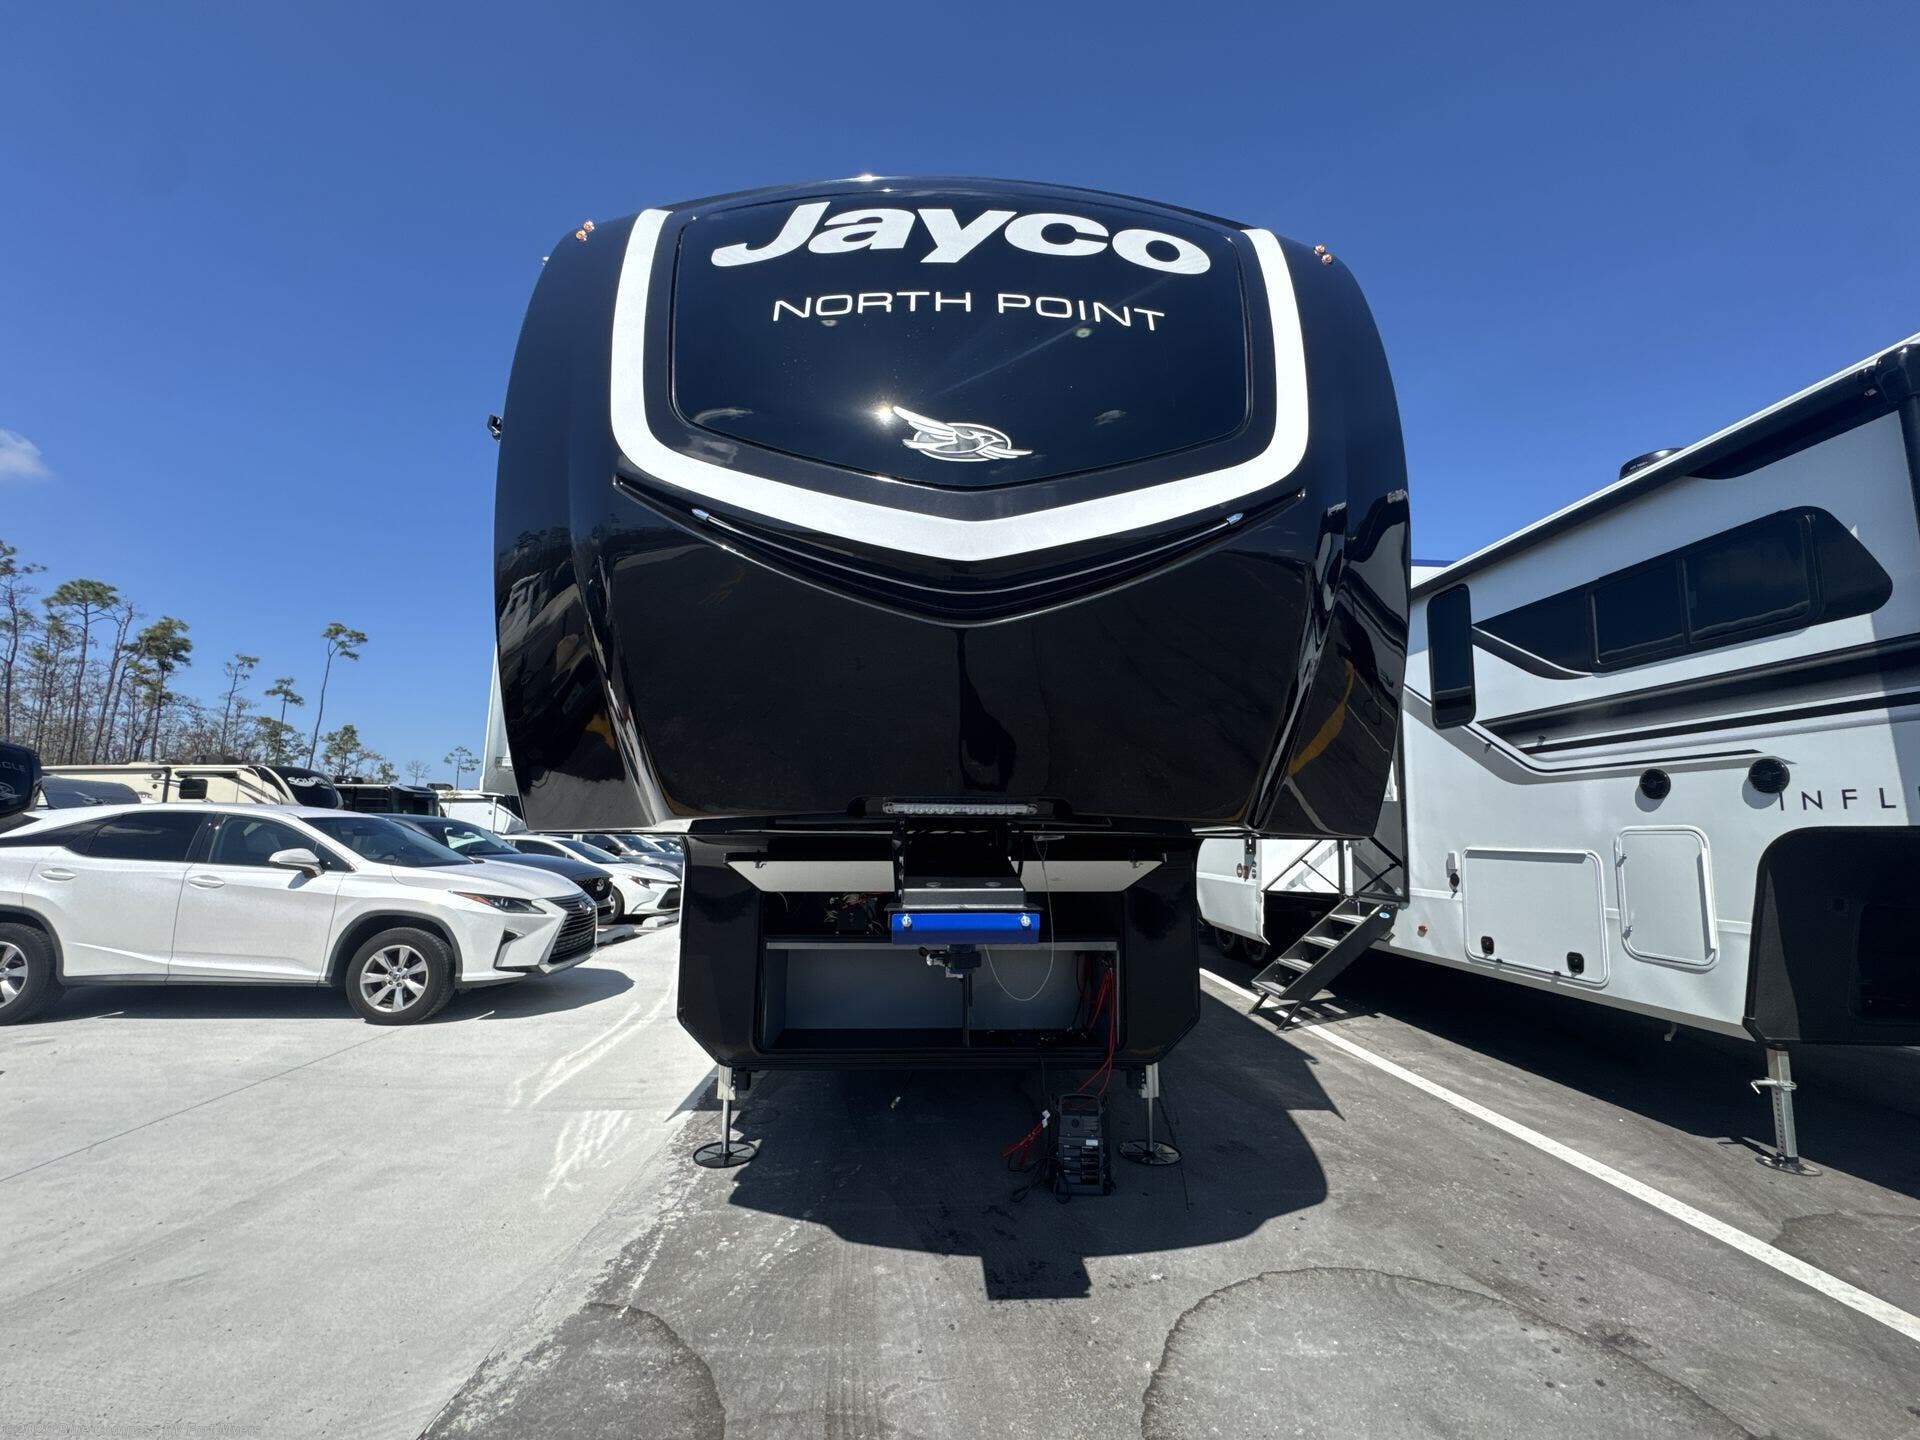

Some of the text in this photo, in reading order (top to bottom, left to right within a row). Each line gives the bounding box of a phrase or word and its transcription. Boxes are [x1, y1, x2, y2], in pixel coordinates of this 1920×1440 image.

[711, 201, 1211, 275] Jayco
[773, 291, 1165, 331] NORTH POINT
[1779, 786, 1920, 811] INFL
